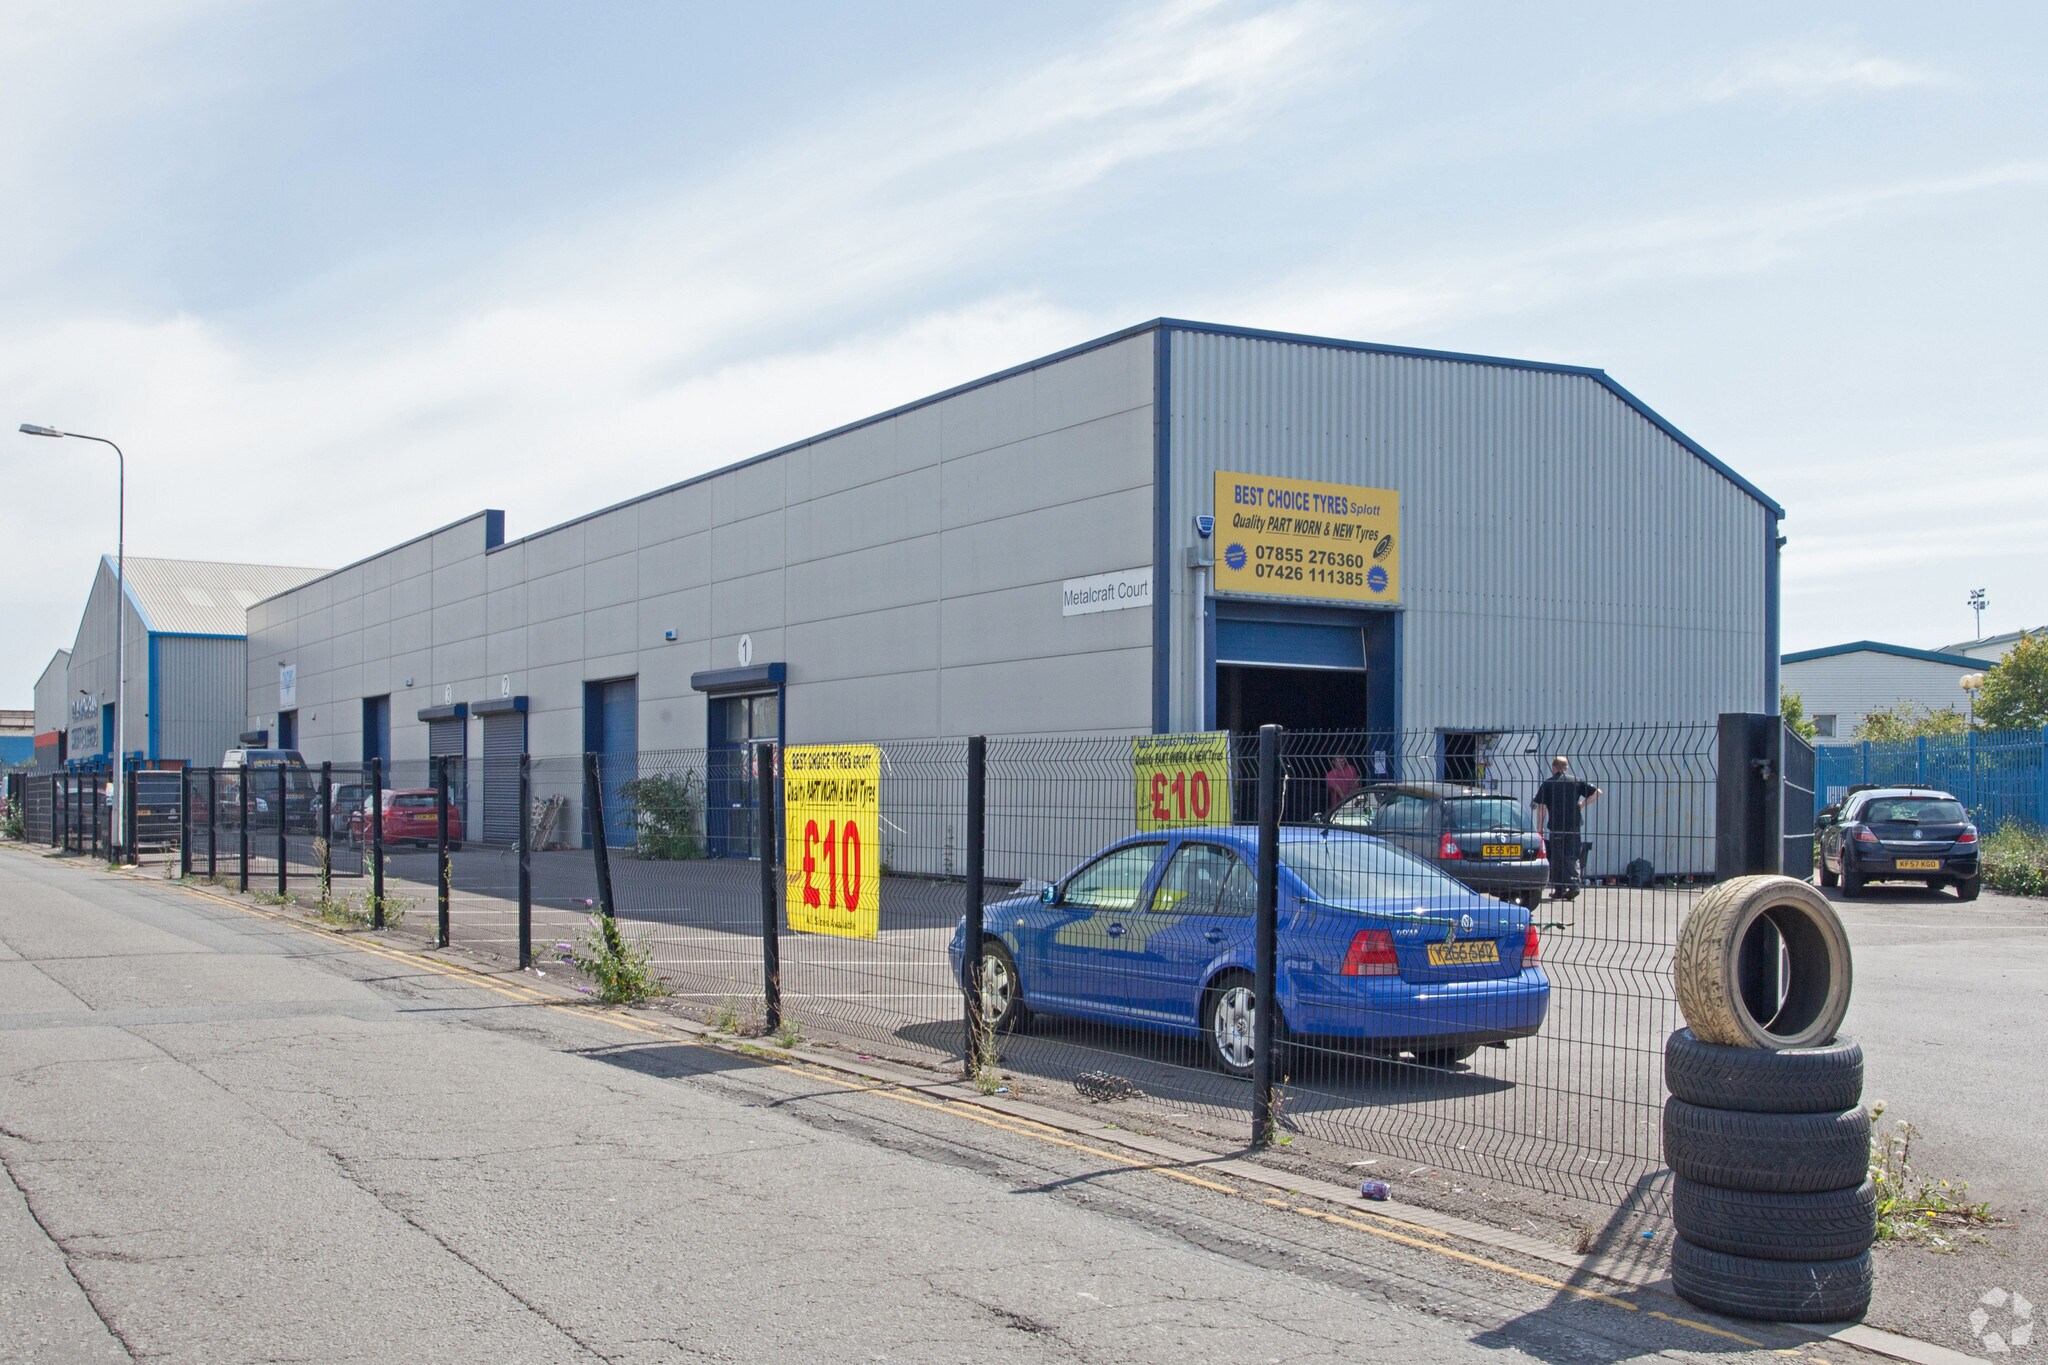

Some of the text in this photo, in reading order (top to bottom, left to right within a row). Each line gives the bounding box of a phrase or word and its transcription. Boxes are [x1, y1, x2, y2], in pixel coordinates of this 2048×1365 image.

[1235, 485, 1380, 516] BEST CHOICE TYRES Splott
[1233, 513, 1265, 534] Quality
[1267, 516, 1292, 533] PART
[1293, 518, 1322, 536] WORN
[1323, 524, 1330, 536] &
[1332, 523, 1354, 539] NEW
[1356, 525, 1378, 543] Tyres
[1255, 545, 1363, 568] 07855 276360
[1255, 564, 1363, 586] 07426 111385
[1064, 580, 1148, 606] Metalcraft Court
[503, 677, 508, 695] 2
[792, 752, 807, 770] BEST
[831, 751, 851, 769] TYRES
[806, 780, 821, 802] PART
[846, 780, 859, 802] NEW
[860, 780, 876, 808] Tyres
[1151, 770, 1210, 821] £10
[803, 819, 861, 912] £10
[1900, 860, 1936, 868] KF57 KGO
